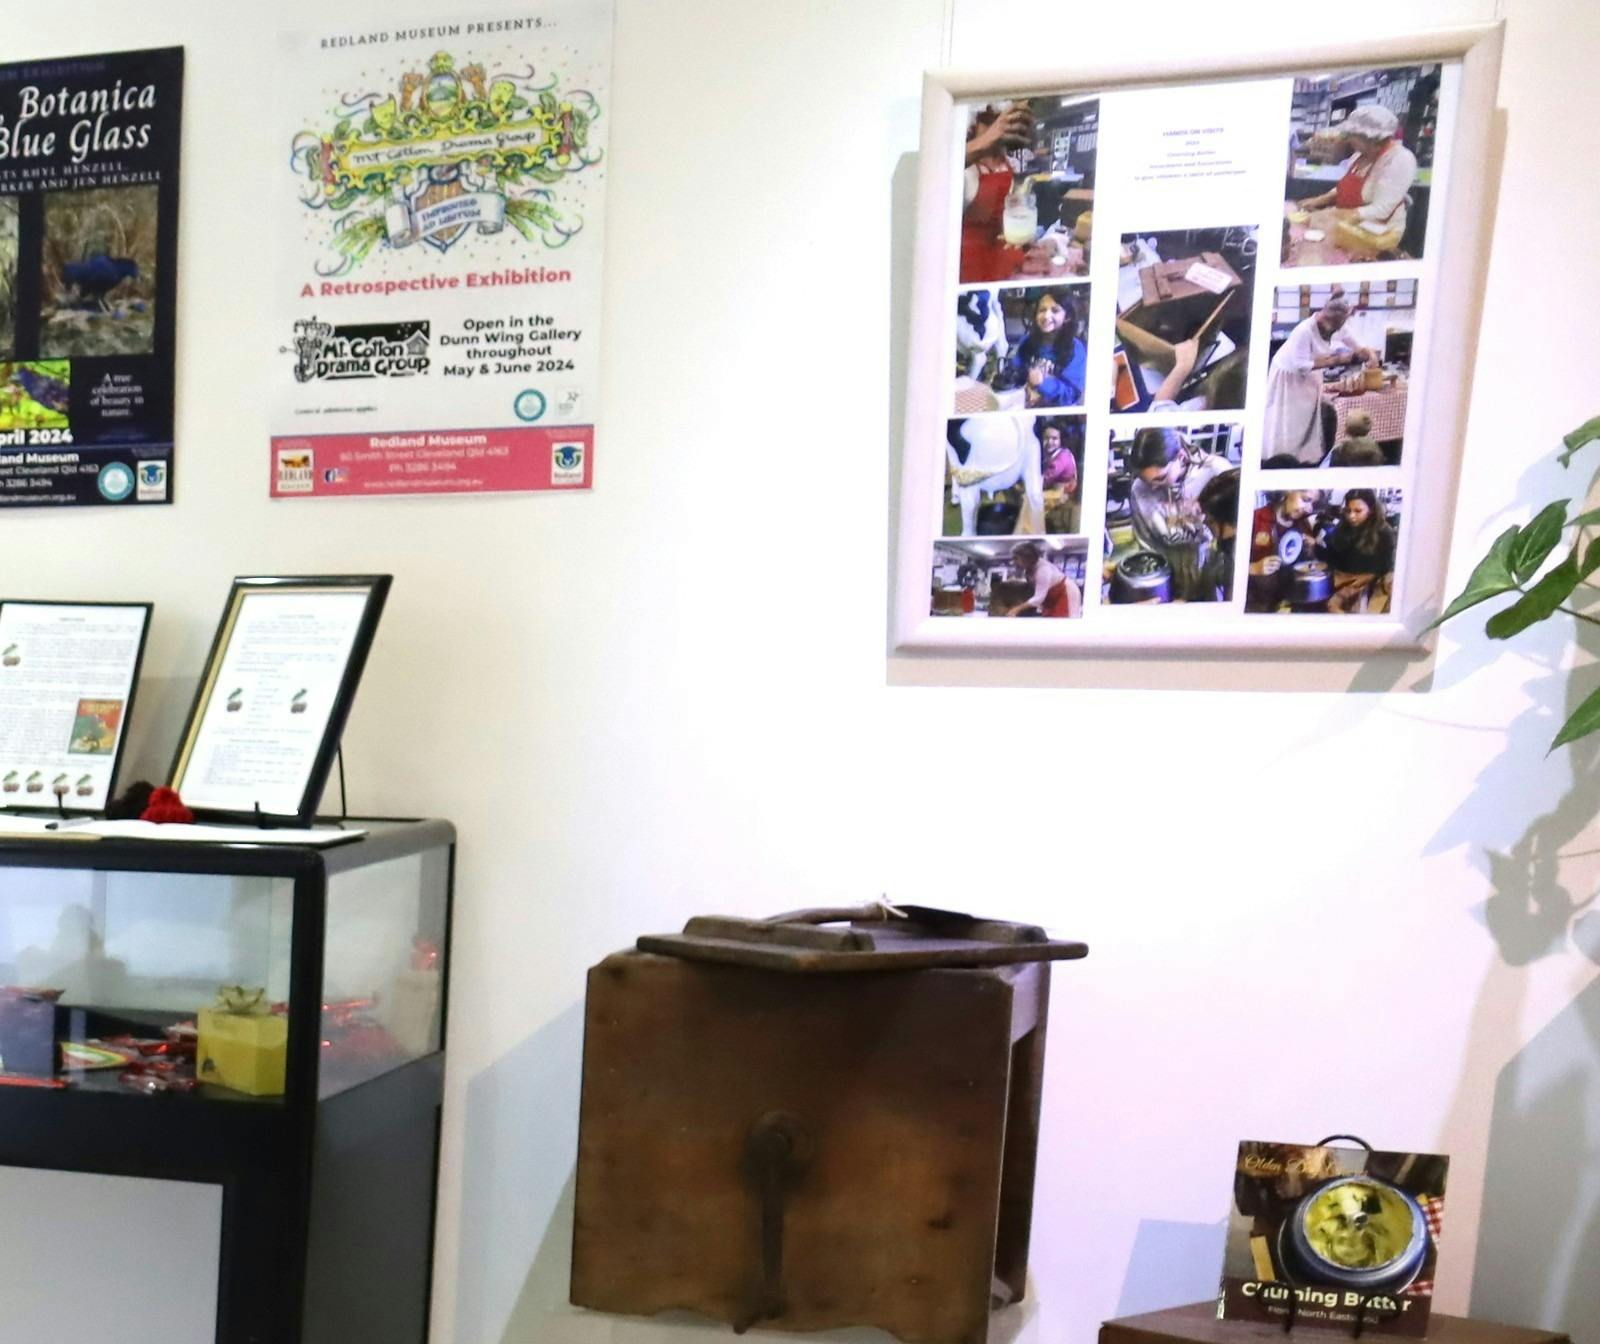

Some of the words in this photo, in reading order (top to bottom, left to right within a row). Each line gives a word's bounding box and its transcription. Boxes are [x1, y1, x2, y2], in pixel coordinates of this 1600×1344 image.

[320, 31, 390, 48] REDLAND
[395, 24, 461, 41] MUSEUM
[18, 79, 157, 120] Botanica
[70, 111, 152, 164] Glass
[22, 166, 57, 179] RHYL
[39, 177, 69, 190] AND
[72, 175, 98, 188] JEN
[102, 170, 162, 184] HENZELL
[300, 283, 315, 297] A
[320, 274, 460, 297] Retrospective
[466, 267, 572, 288] Exhibition
[463, 318, 505, 333] Open
[509, 316, 524, 329] in
[528, 315, 554, 327] the
[440, 333, 480, 346] Dunn
[484, 330, 524, 346] Wing
[529, 328, 582, 344] Gallery
[351, 339, 404, 358] Cotton
[466, 344, 553, 361] throughout
[317, 360, 371, 378] Drama
[374, 356, 430, 376] Group
[443, 364, 475, 378] May
[480, 364, 489, 375] &
[495, 361, 531, 375] June
[536, 359, 574, 372] 2024
[29, 427, 74, 444] 2024
[370, 435, 425, 448] Redland
[428, 434, 487, 446] Museum
[26, 452, 80, 464] Museum
[15, 464, 60, 475] Cleveland
[61, 464, 78, 475] Qld
